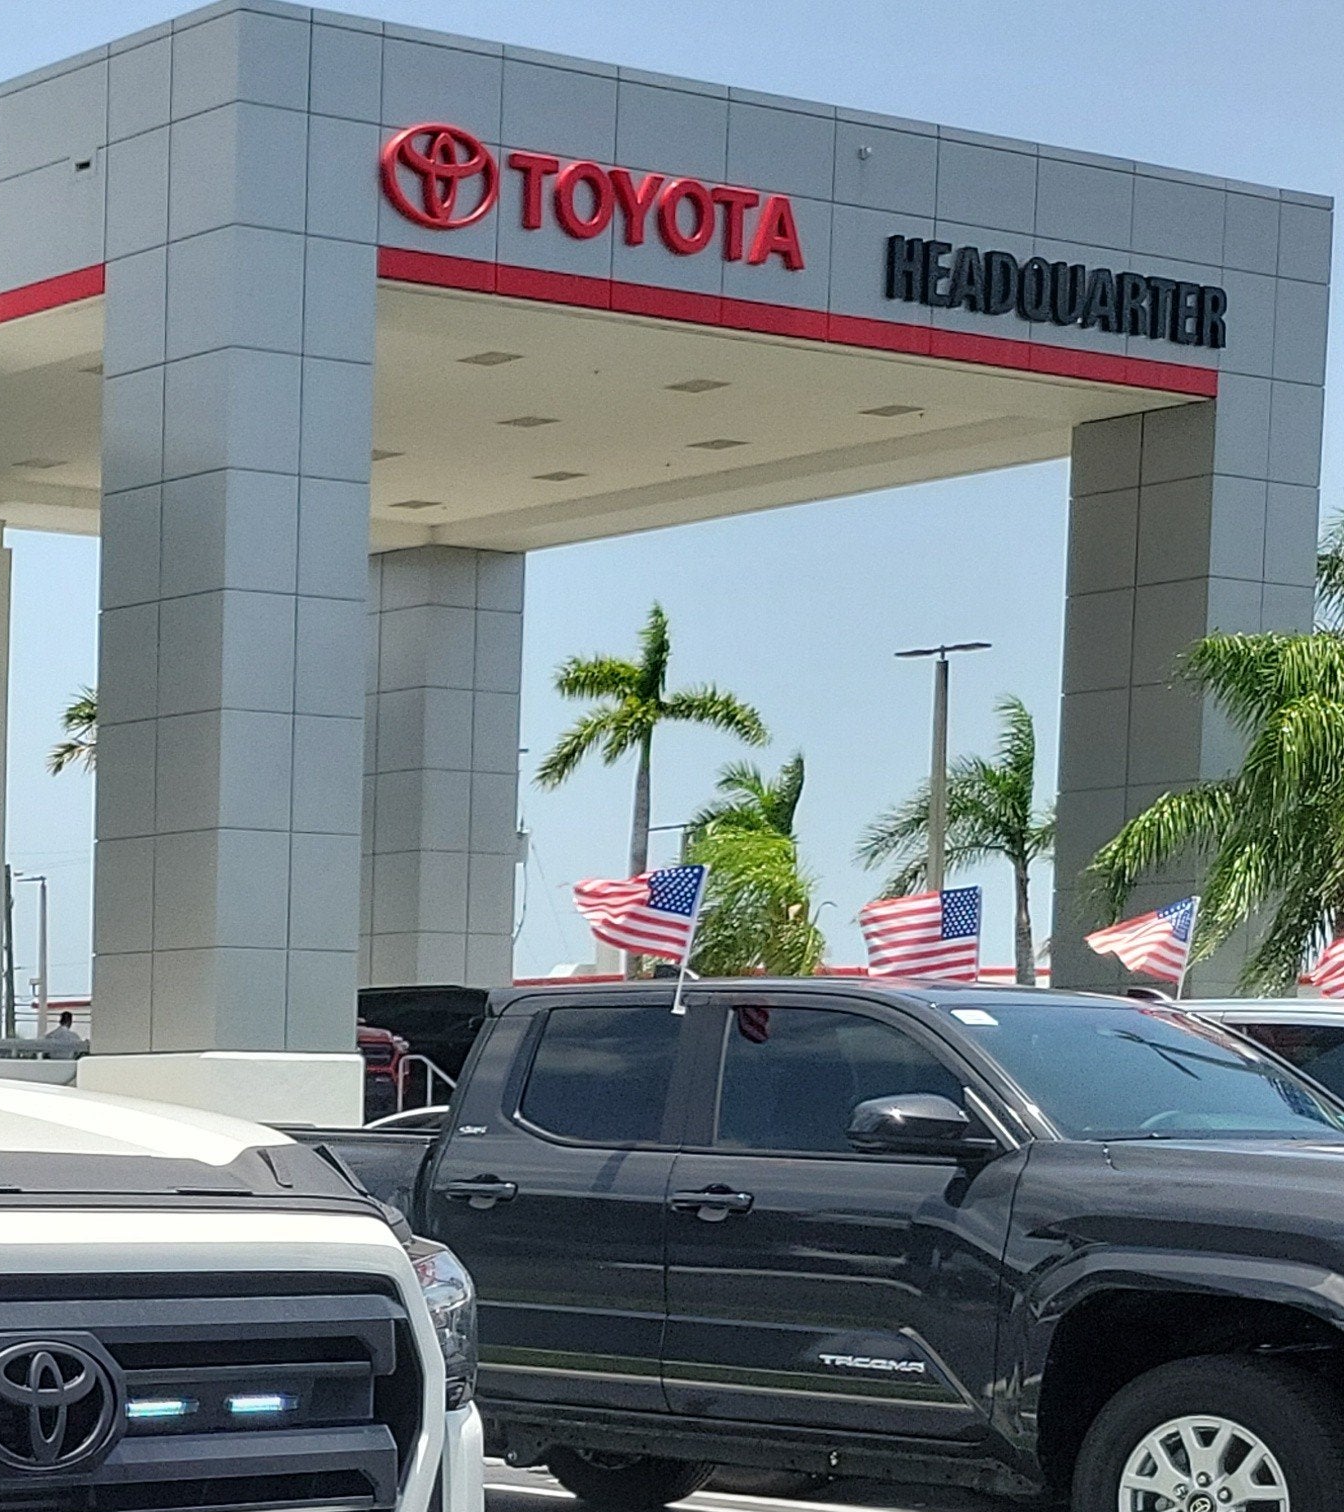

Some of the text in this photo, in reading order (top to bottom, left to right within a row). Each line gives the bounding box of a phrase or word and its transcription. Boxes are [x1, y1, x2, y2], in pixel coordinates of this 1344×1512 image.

[509, 150, 805, 272] TOYOTA
[886, 234, 1227, 349] HEADQUARTER
[818, 1353, 925, 1373] TACOMA
